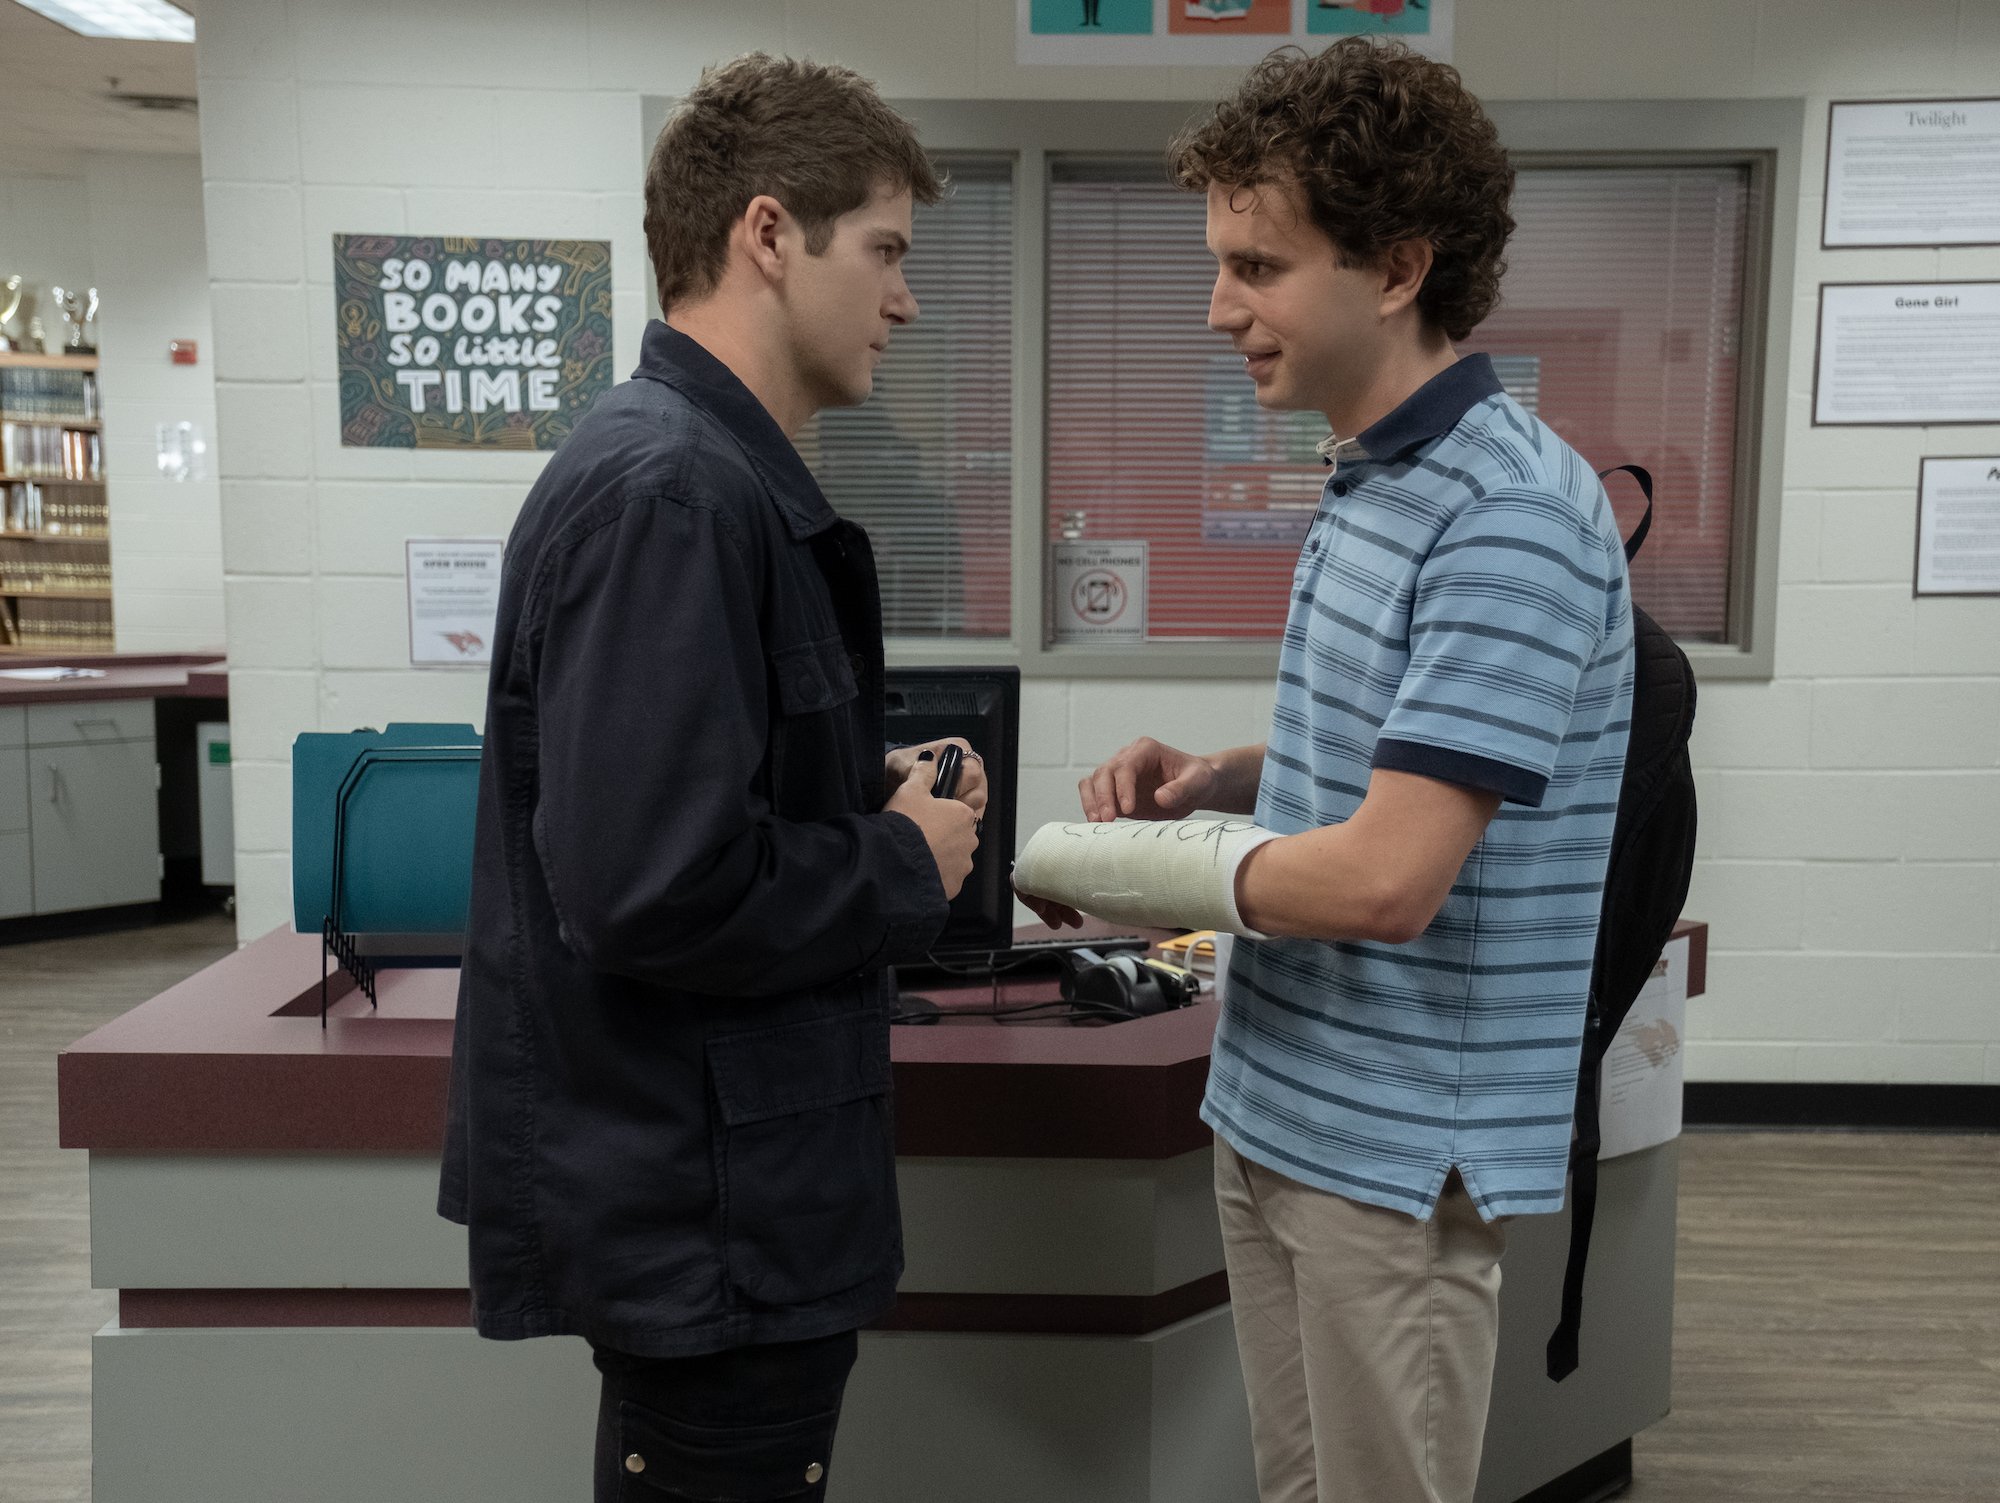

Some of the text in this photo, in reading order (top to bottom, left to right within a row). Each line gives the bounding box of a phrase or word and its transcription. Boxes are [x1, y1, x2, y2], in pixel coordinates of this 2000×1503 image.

[1905, 110, 1967, 128] Twilight
[379, 258, 563, 294] SO MANY
[383, 292, 563, 334] BOOKS
[1895, 296, 1959, 309] Gone Girl
[387, 334, 441, 367] SO
[396, 369, 560, 414] TIME
